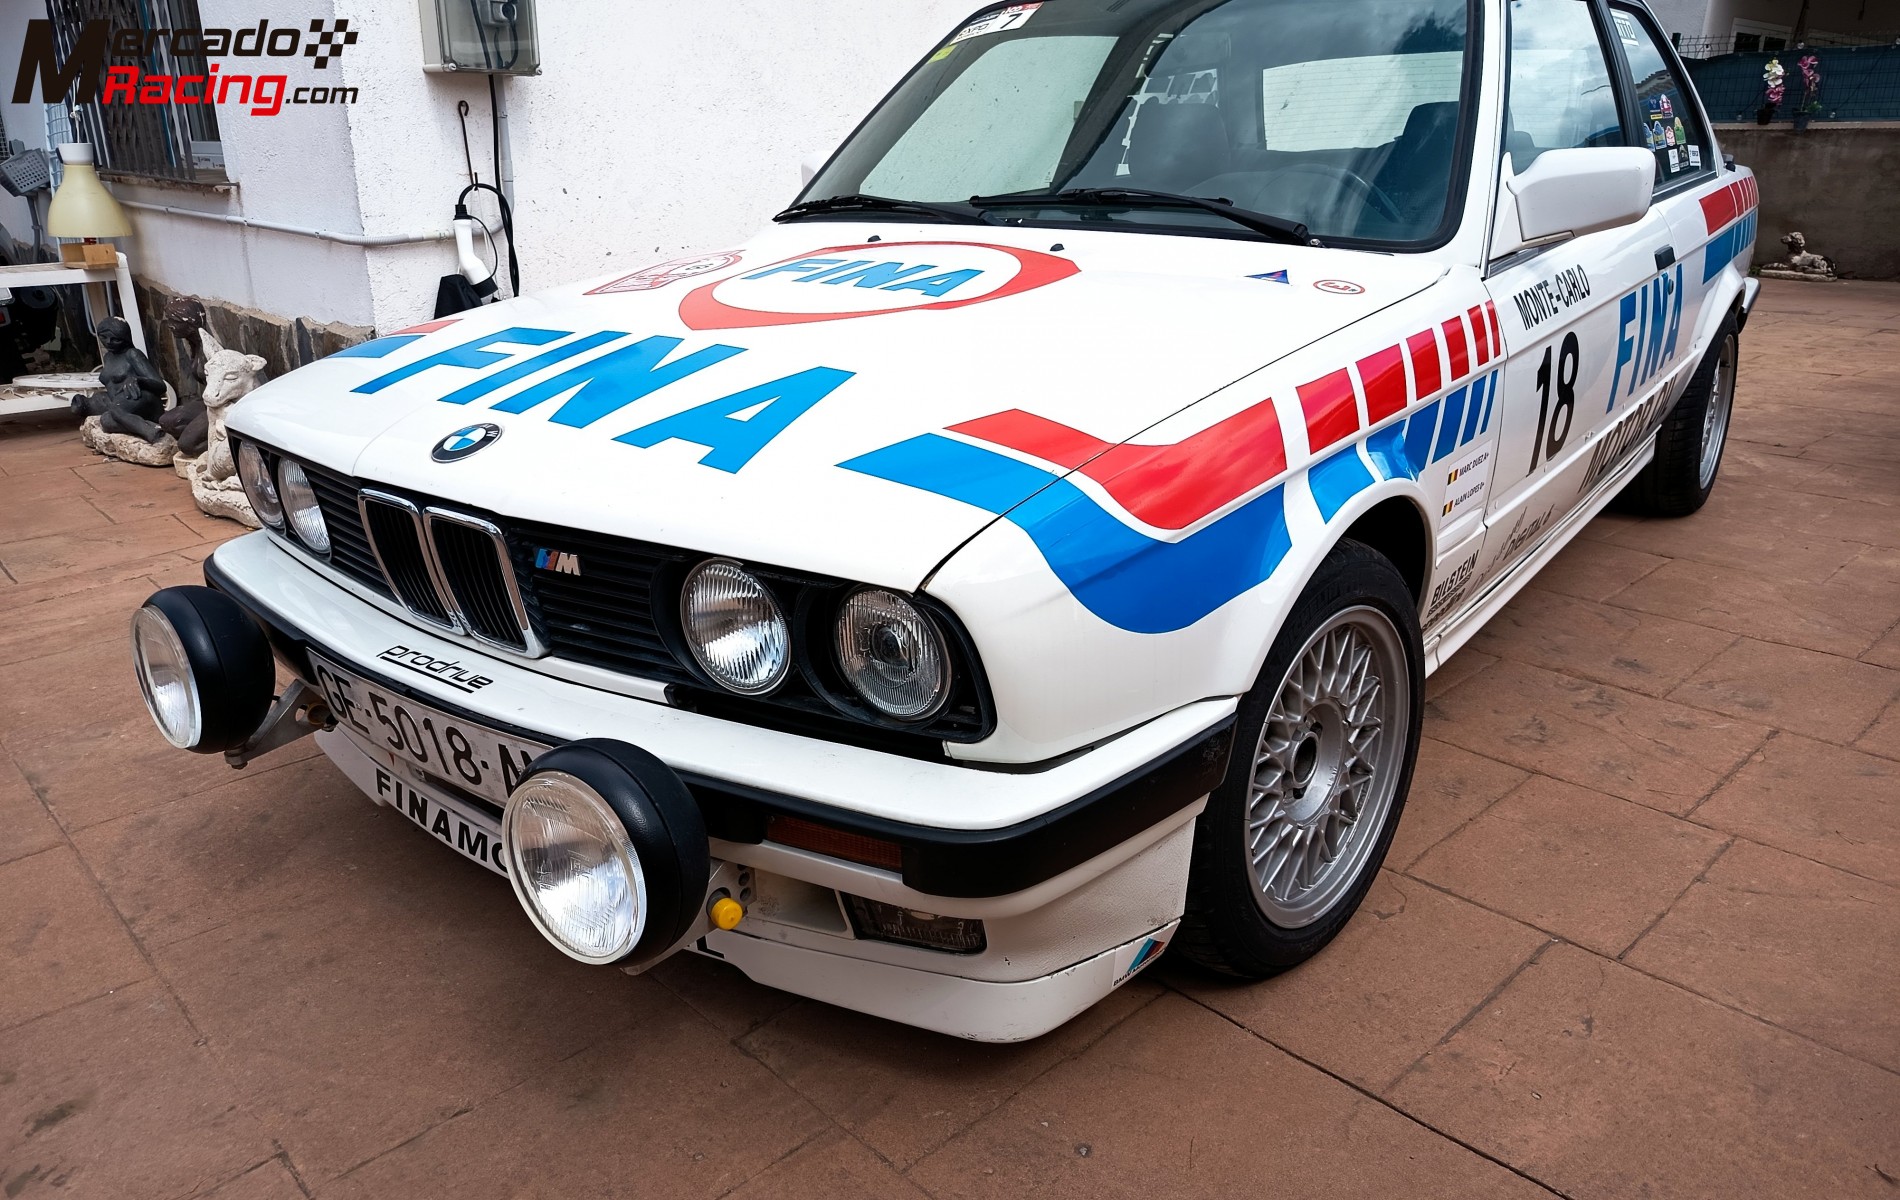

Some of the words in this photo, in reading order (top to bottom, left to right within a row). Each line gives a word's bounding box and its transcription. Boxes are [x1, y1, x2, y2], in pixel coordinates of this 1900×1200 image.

[1000, 13, 1023, 29] 7
[741, 259, 985, 297] FINA
[1513, 264, 1591, 331] MONTE-CARLO
[1606, 262, 1683, 414] FINA
[349, 326, 857, 475] FINA
[1525, 331, 1580, 477] 18
[1577, 395, 1654, 494] MOTOR
[1430, 549, 1479, 607] BILSTEIN
